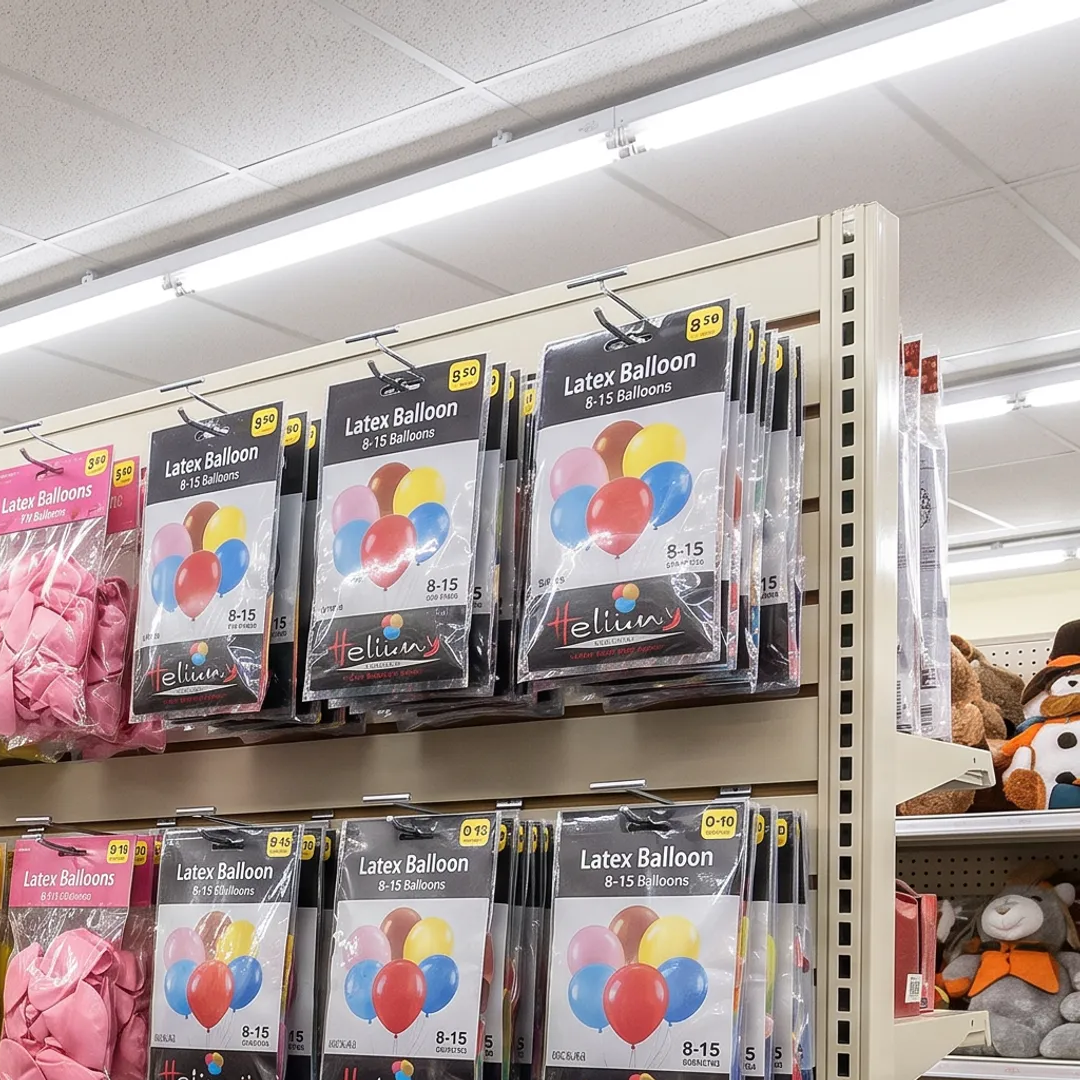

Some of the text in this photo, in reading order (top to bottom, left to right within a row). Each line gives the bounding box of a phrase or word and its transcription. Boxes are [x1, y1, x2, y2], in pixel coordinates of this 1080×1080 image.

[563, 351, 697, 397] Latex Balloon
[585, 380, 672, 409] 8-15 Balloons
[345, 401, 458, 437] Latex Balloon
[361, 427, 436, 451] 8-15 Balloons
[165, 445, 260, 478] Latex Balloon
[180, 471, 240, 491] 8-15 Balloons
[1, 482, 93, 515] Latex Balloons
[666, 541, 705, 560] 8-15
[426, 577, 459, 593] 8-15
[228, 608, 257, 622] 8-15
[359, 852, 469, 875] Latex Balloon
[580, 845, 714, 870] Latex Balloon
[23, 867, 115, 888] Latex Balloons
[176, 861, 274, 881] Latex Balloon
[604, 874, 690, 888] 8-15 Balloons
[378, 878, 446, 892] 8-15 Balloons
[241, 1025, 270, 1039] 8-15
[435, 1030, 468, 1046] 8-15
[682, 1041, 721, 1057] 8-15
